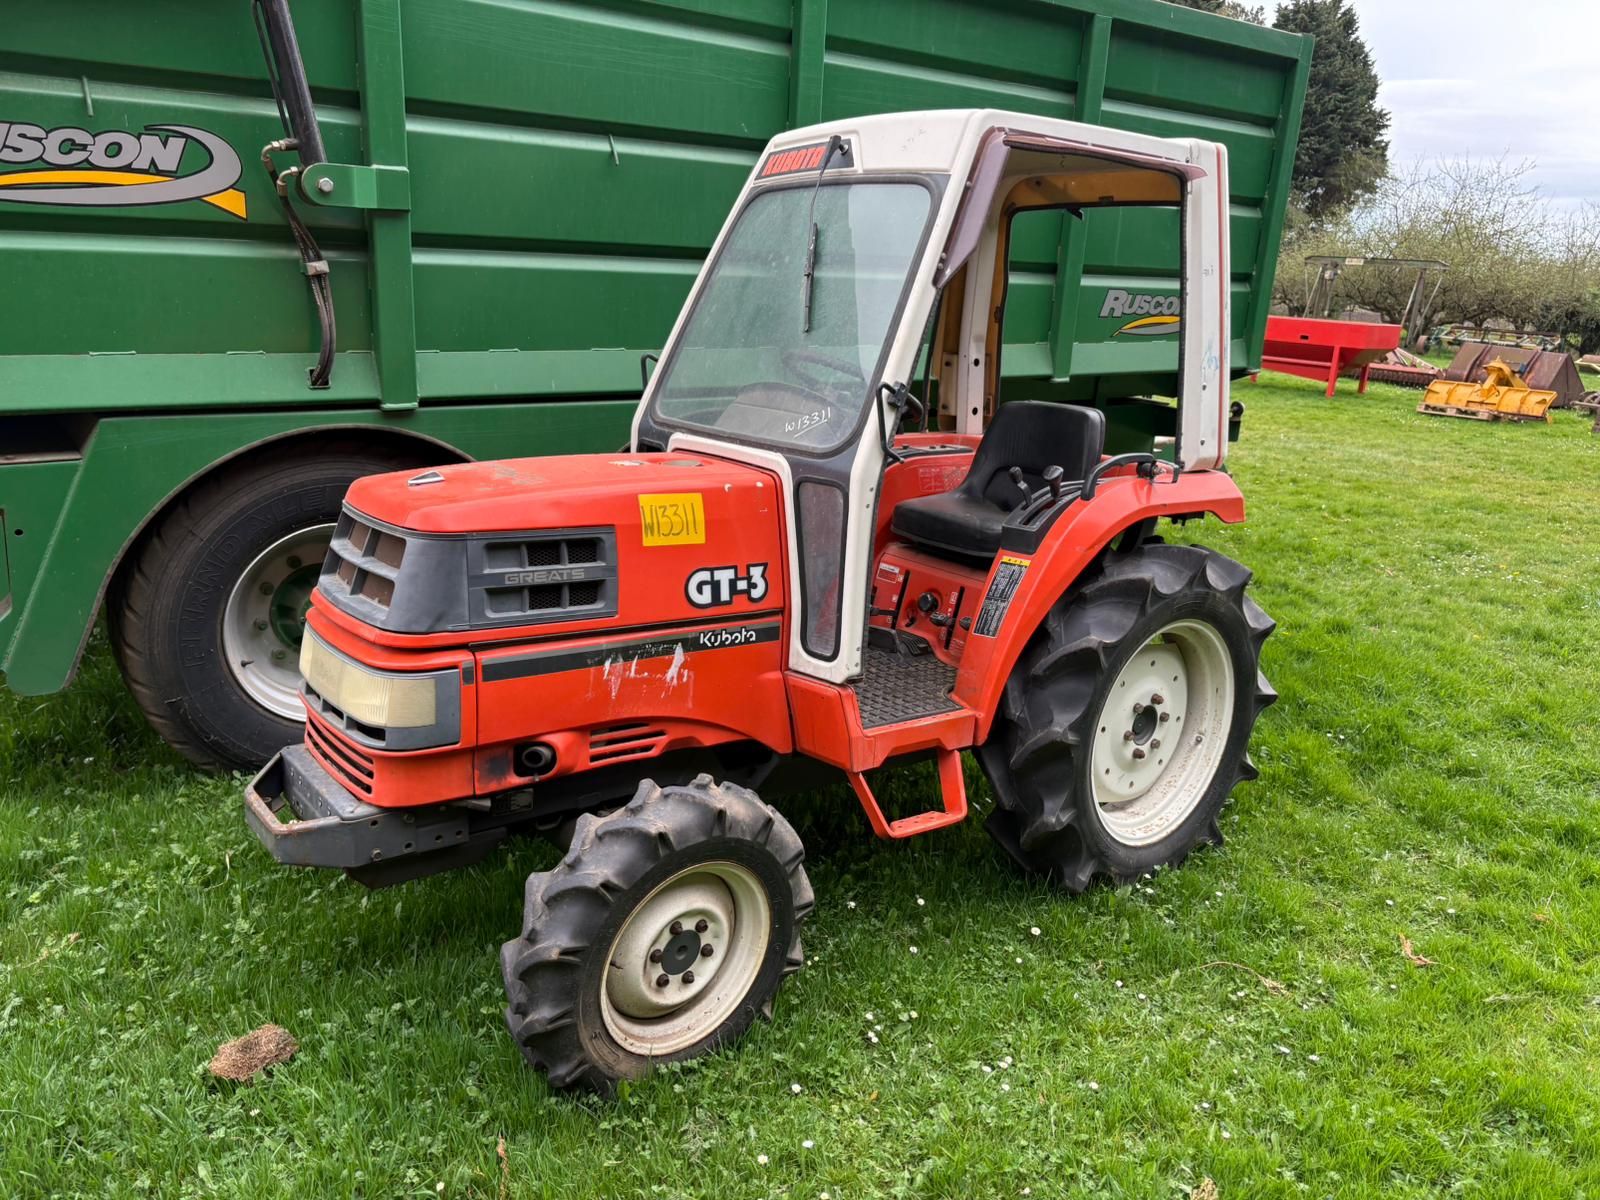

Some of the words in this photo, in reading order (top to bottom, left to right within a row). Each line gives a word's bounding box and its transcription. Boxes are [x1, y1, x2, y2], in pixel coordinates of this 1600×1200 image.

[0, 121, 188, 174] SCON
[761, 145, 827, 177] KUBOTA
[1099, 288, 1181, 318] RUSCO
[785, 406, 831, 433] W13311
[641, 502, 699, 538] W13311
[504, 568, 585, 585] GREATS
[686, 563, 768, 608] GT-3
[700, 627, 756, 647] Kubota
